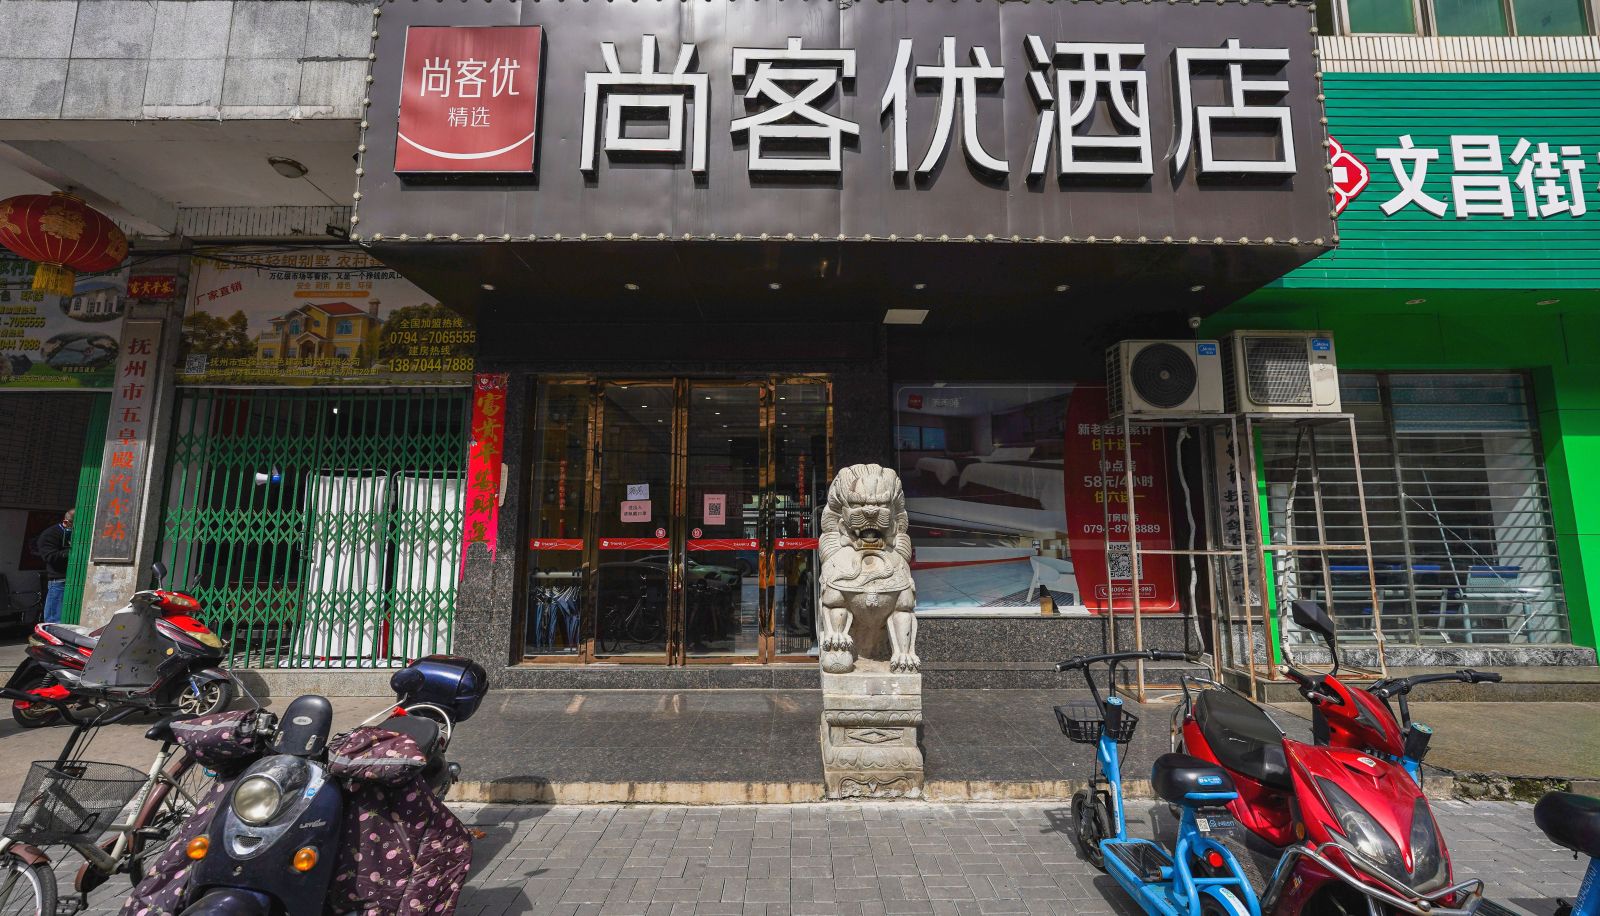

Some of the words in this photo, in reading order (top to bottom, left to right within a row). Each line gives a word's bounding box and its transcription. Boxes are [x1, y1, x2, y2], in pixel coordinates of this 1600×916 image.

[419, 57, 521, 99] 尚客优
[447, 106, 491, 128] 精选
[579, 33, 1297, 180] 尚客优酒店
[1375, 134, 1600, 220] 文昌街
[196, 281, 243, 306] 厂家直销
[399, 318, 465, 329] 全国加盟热线
[408, 346, 451, 356] 建房热线
[102, 337, 152, 543] 抚州市五皇殿汽车站
[1083, 524, 1161, 534] 079-878889
